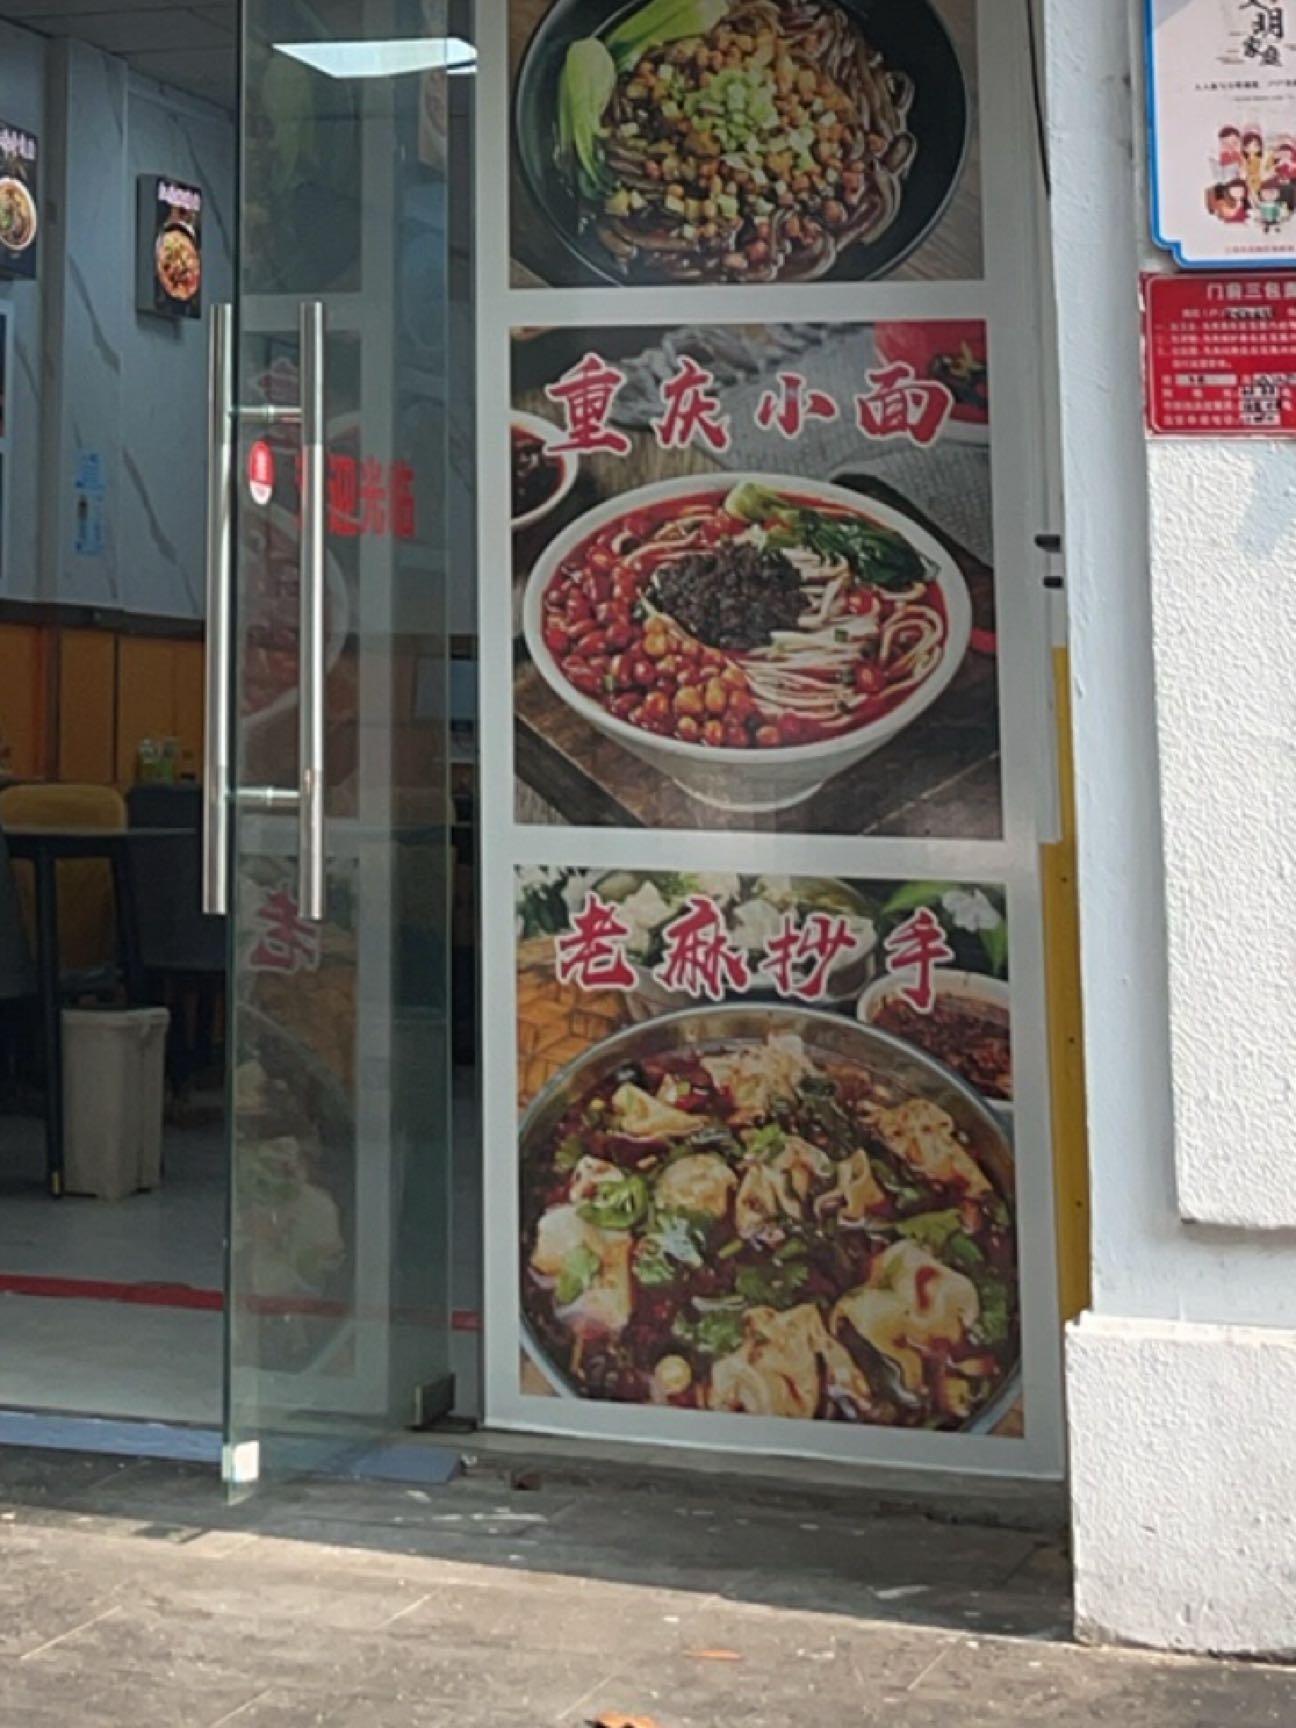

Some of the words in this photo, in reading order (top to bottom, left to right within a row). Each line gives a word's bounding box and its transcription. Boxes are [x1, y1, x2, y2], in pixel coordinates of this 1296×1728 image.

[544, 349, 955, 457] 重庆小面
[296, 452, 417, 539] 迎光临
[554, 889, 958, 1016] 老麻抄手
